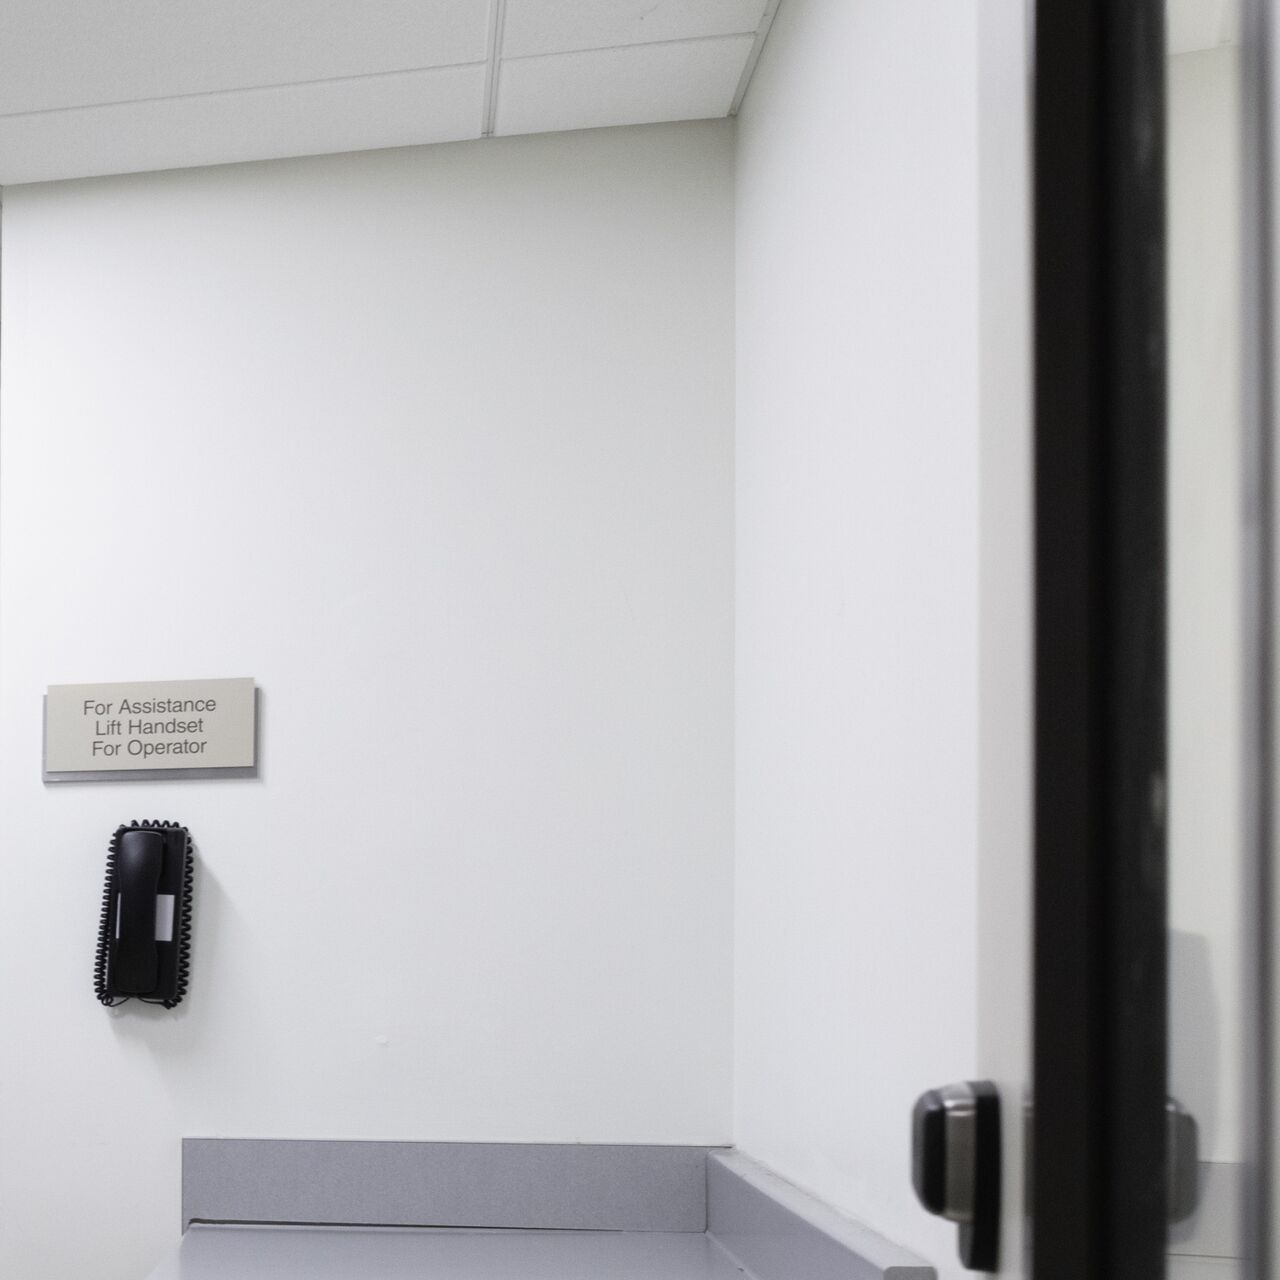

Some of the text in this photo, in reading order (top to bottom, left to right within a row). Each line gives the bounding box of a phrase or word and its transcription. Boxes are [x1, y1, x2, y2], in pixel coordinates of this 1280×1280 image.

[83, 697, 217, 716] For Assistance
[95, 717, 204, 736] Lift Handset
[92, 738, 208, 759] For Operator
